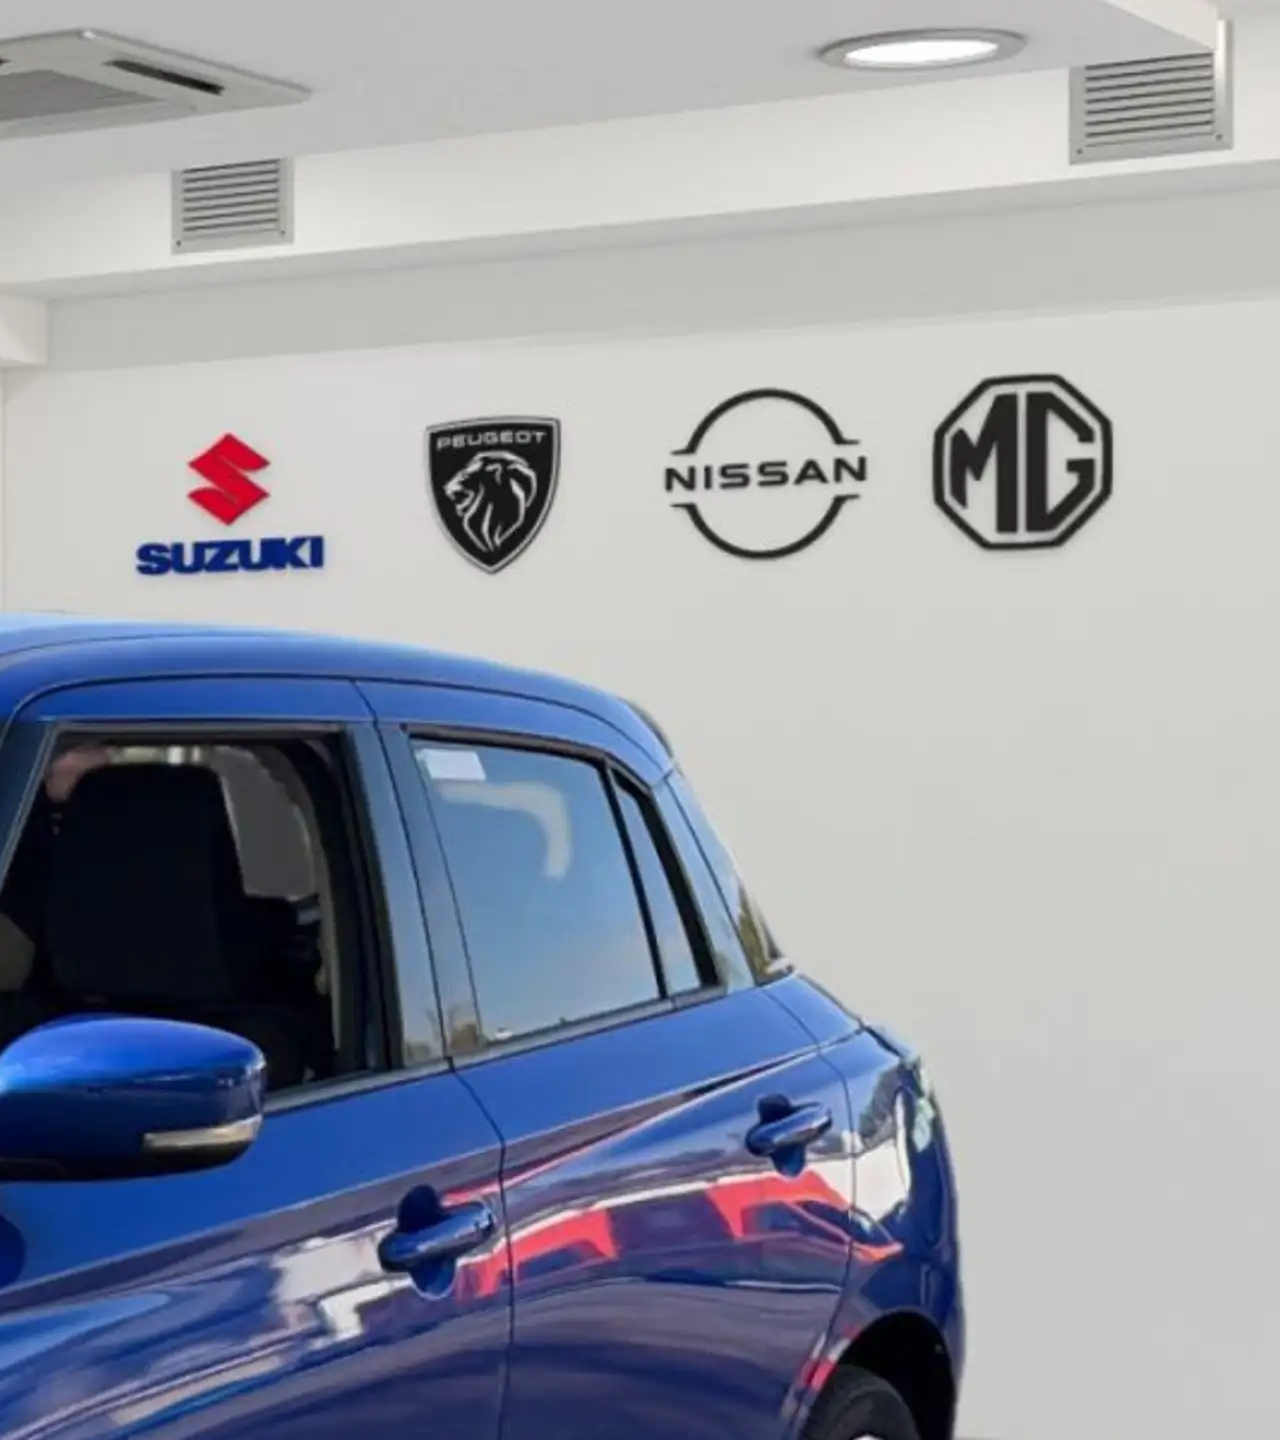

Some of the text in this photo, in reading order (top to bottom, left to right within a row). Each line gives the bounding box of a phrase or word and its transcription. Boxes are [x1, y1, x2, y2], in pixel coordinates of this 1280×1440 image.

[436, 429, 547, 450] PEUGEOT
[664, 455, 867, 493] NISSAN
[949, 391, 1097, 534] MG
[134, 533, 327, 577] SUZUKI
